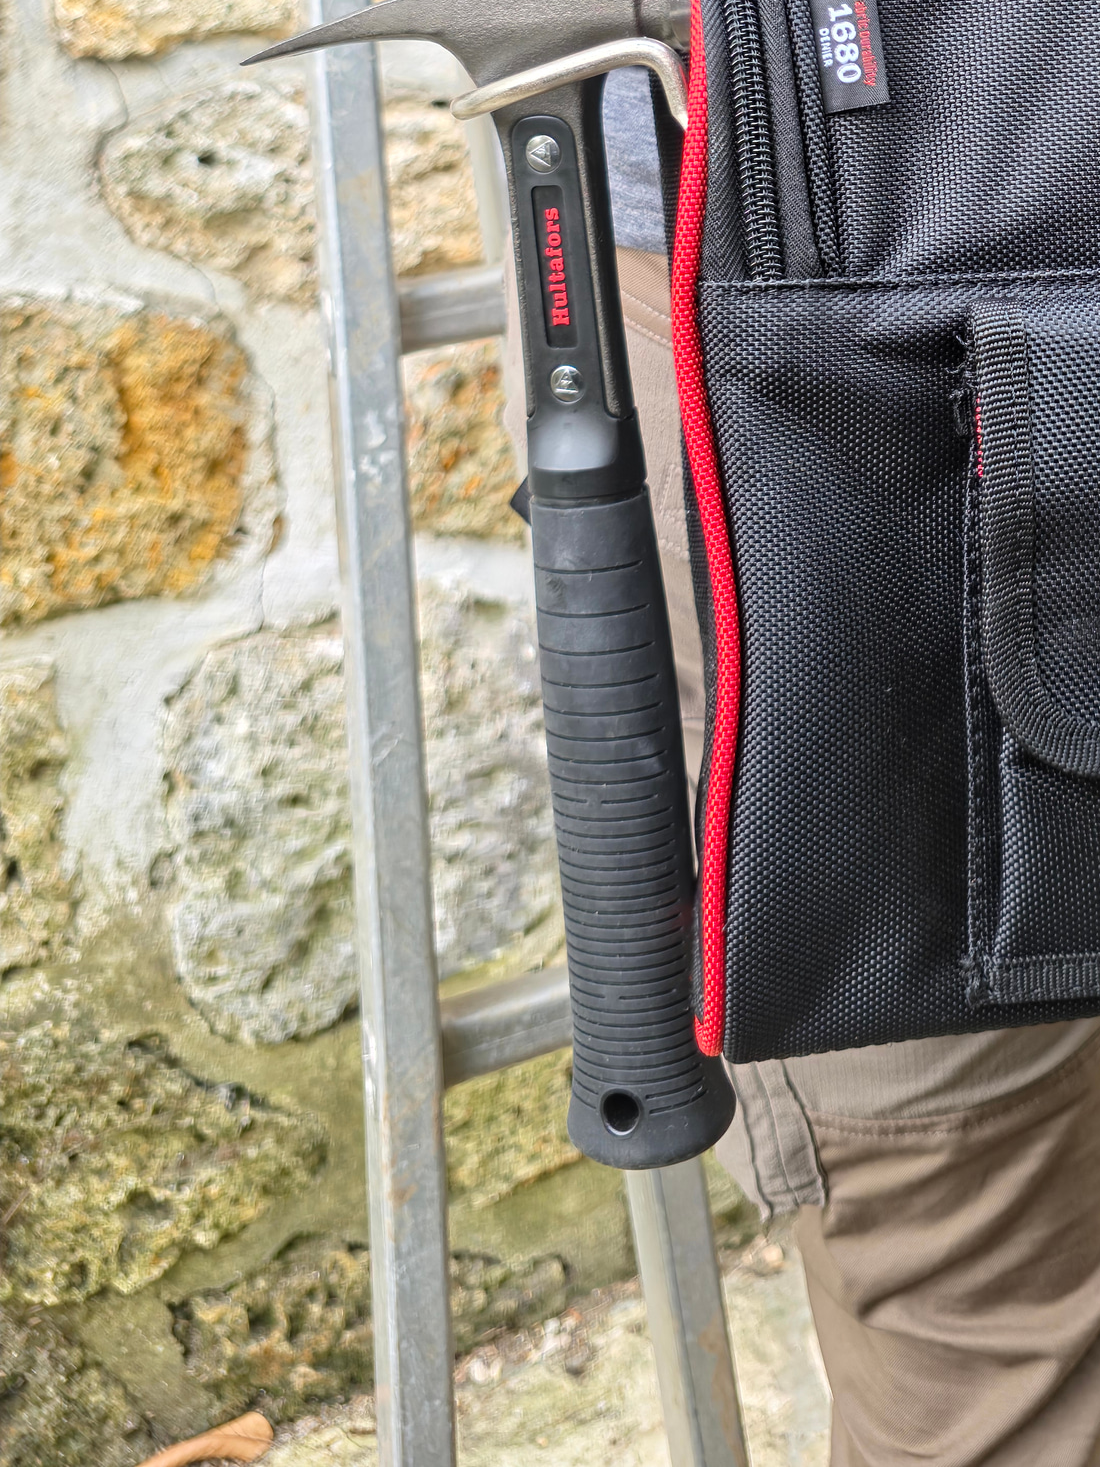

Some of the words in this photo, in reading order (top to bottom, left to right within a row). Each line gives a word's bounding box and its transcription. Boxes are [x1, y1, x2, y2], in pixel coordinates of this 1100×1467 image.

[819, 27, 833, 67] DENIER
[828, 3, 860, 83] 1680
[860, 30, 877, 86] Durability
[545, 207, 570, 326] Hultafors
